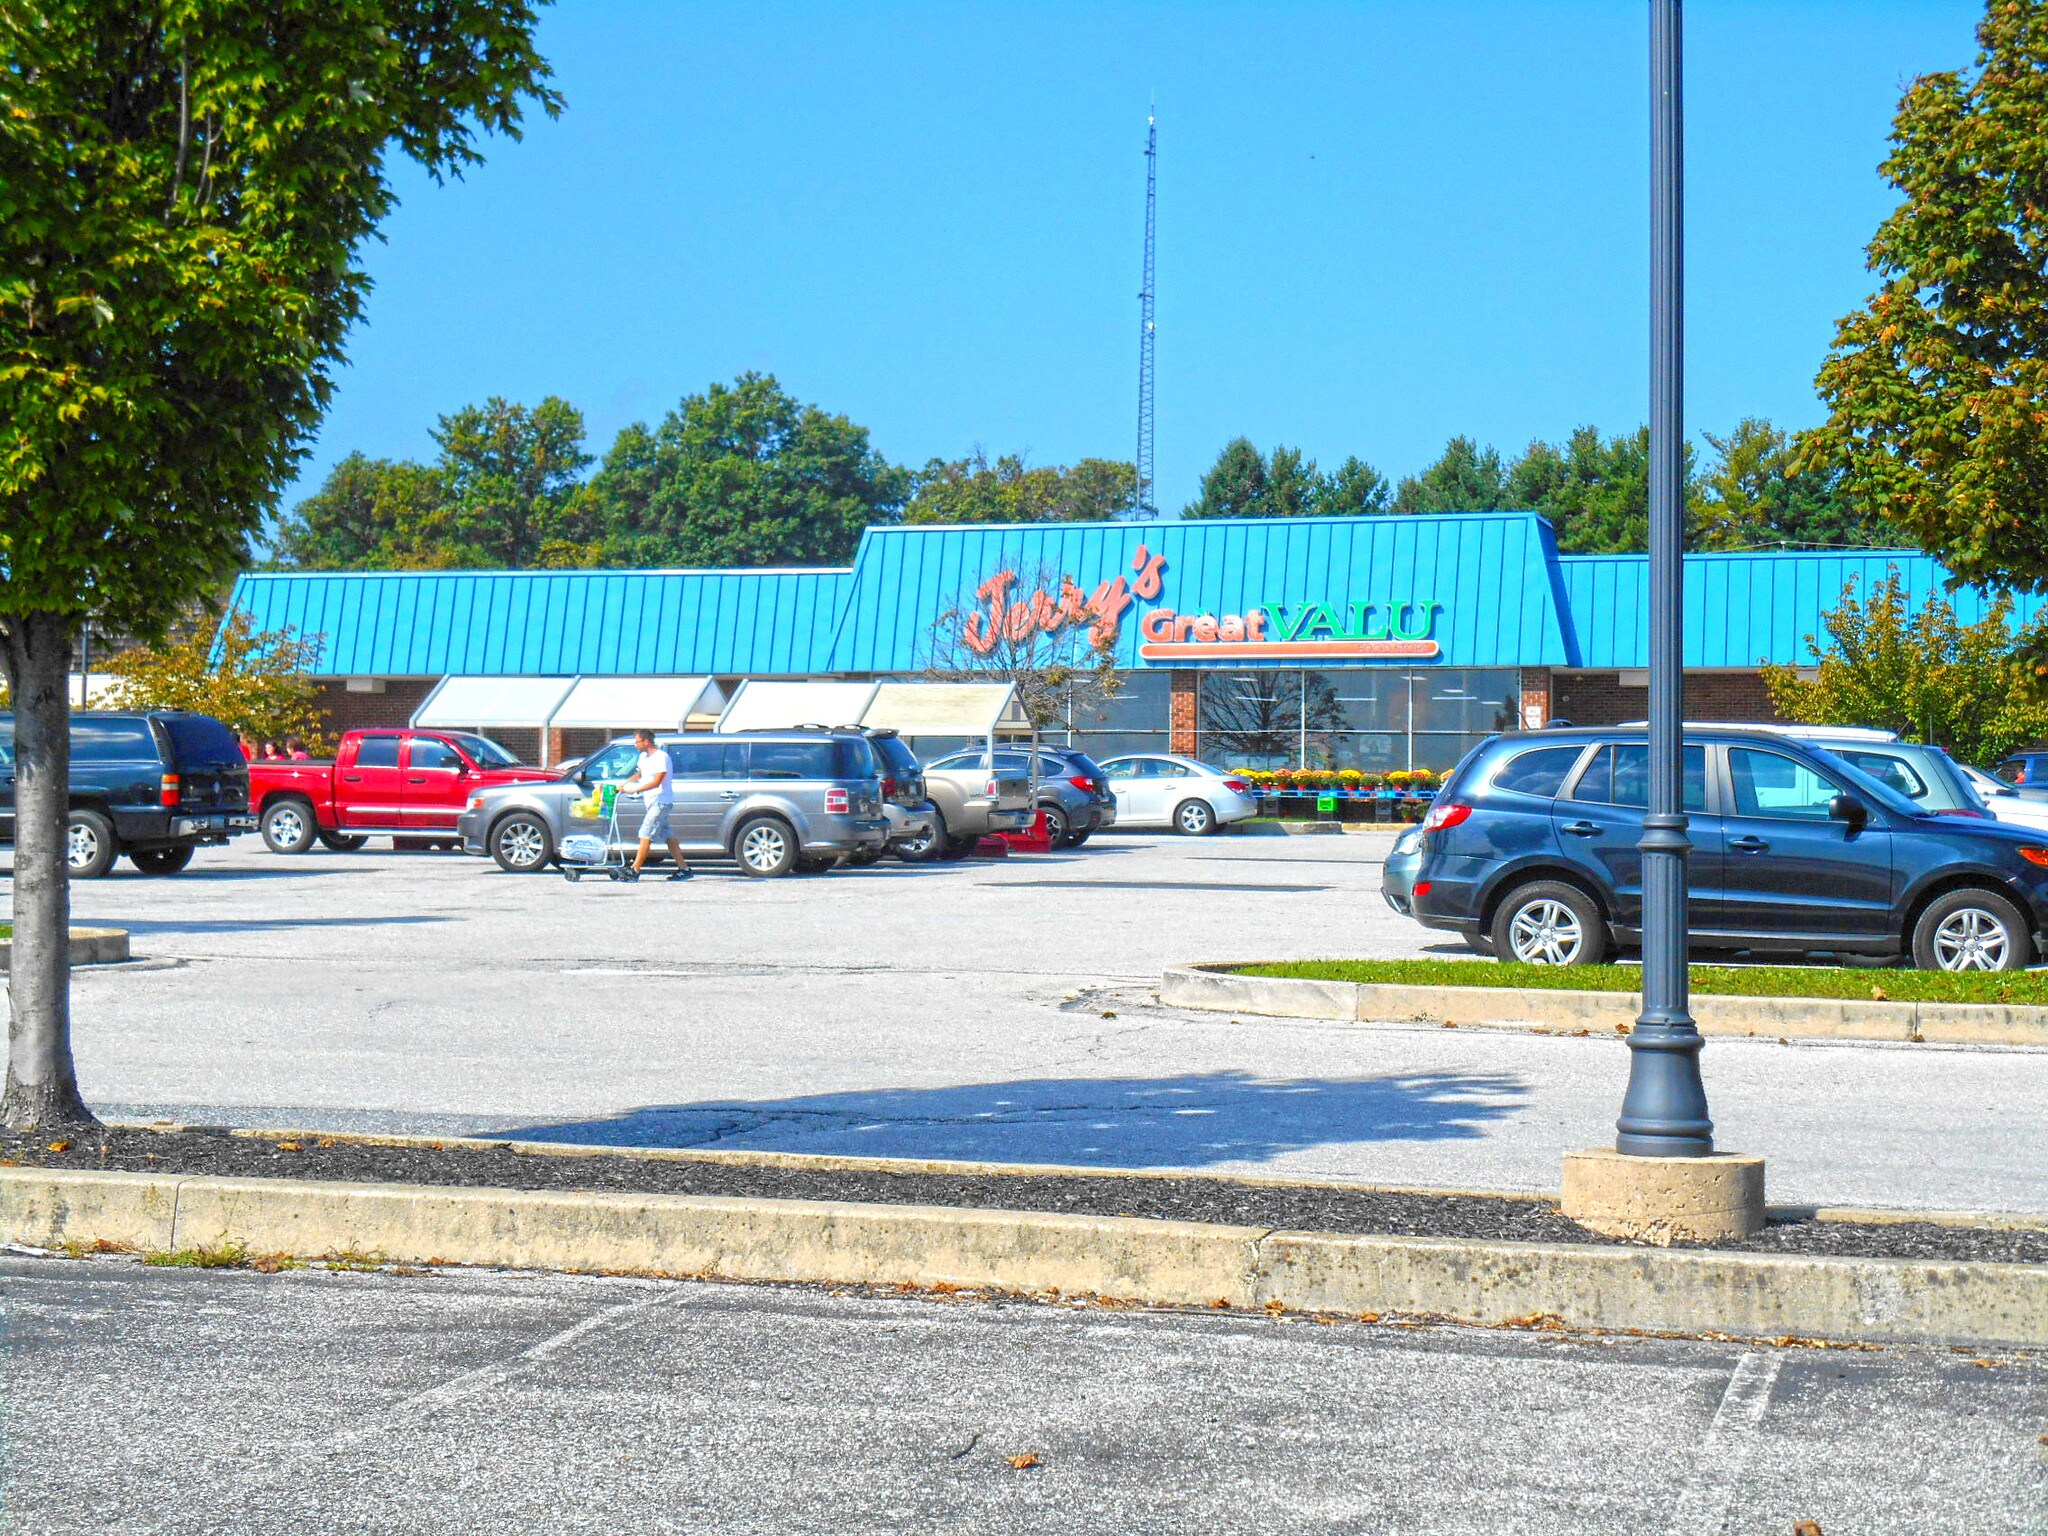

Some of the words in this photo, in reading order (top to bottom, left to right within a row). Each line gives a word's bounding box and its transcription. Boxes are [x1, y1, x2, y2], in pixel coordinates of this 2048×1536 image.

[964, 544, 1165, 653] Jerry's
[1141, 608, 1264, 642] Great
[1261, 599, 1439, 640] VALU
